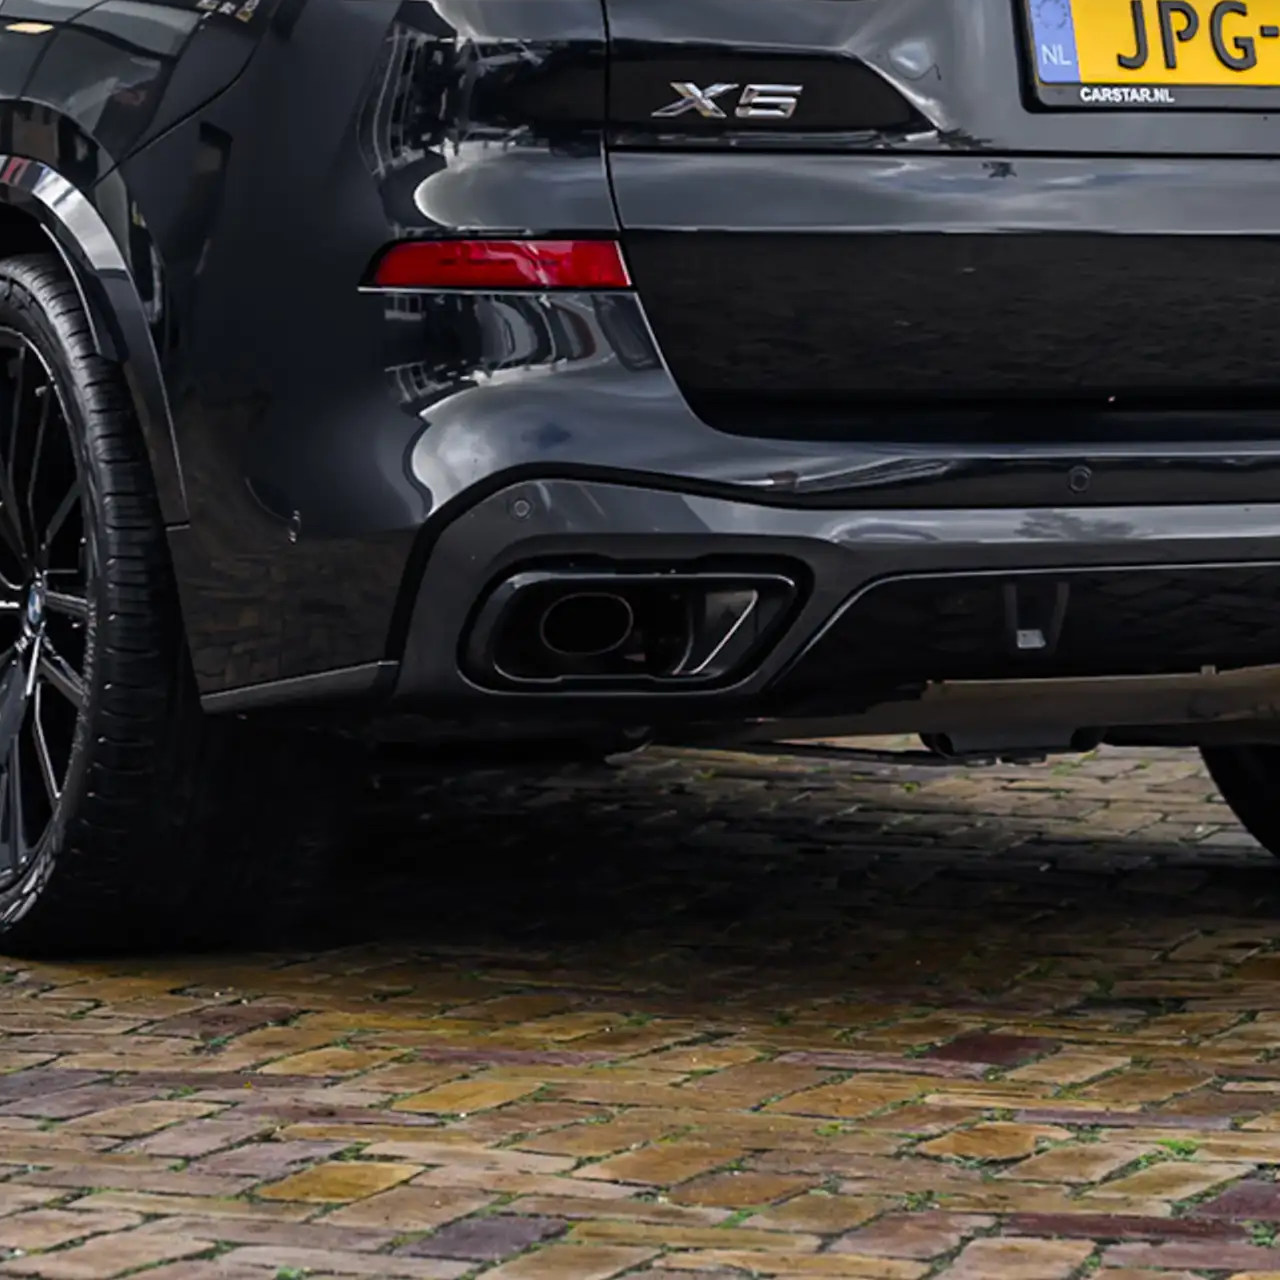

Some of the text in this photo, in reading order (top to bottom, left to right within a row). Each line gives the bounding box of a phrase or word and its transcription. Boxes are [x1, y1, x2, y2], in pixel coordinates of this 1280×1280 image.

[1042, 43, 1072, 67] NL
[650, 82, 803, 119] X5
[1080, 86, 1175, 103] CARSTAR.NL
